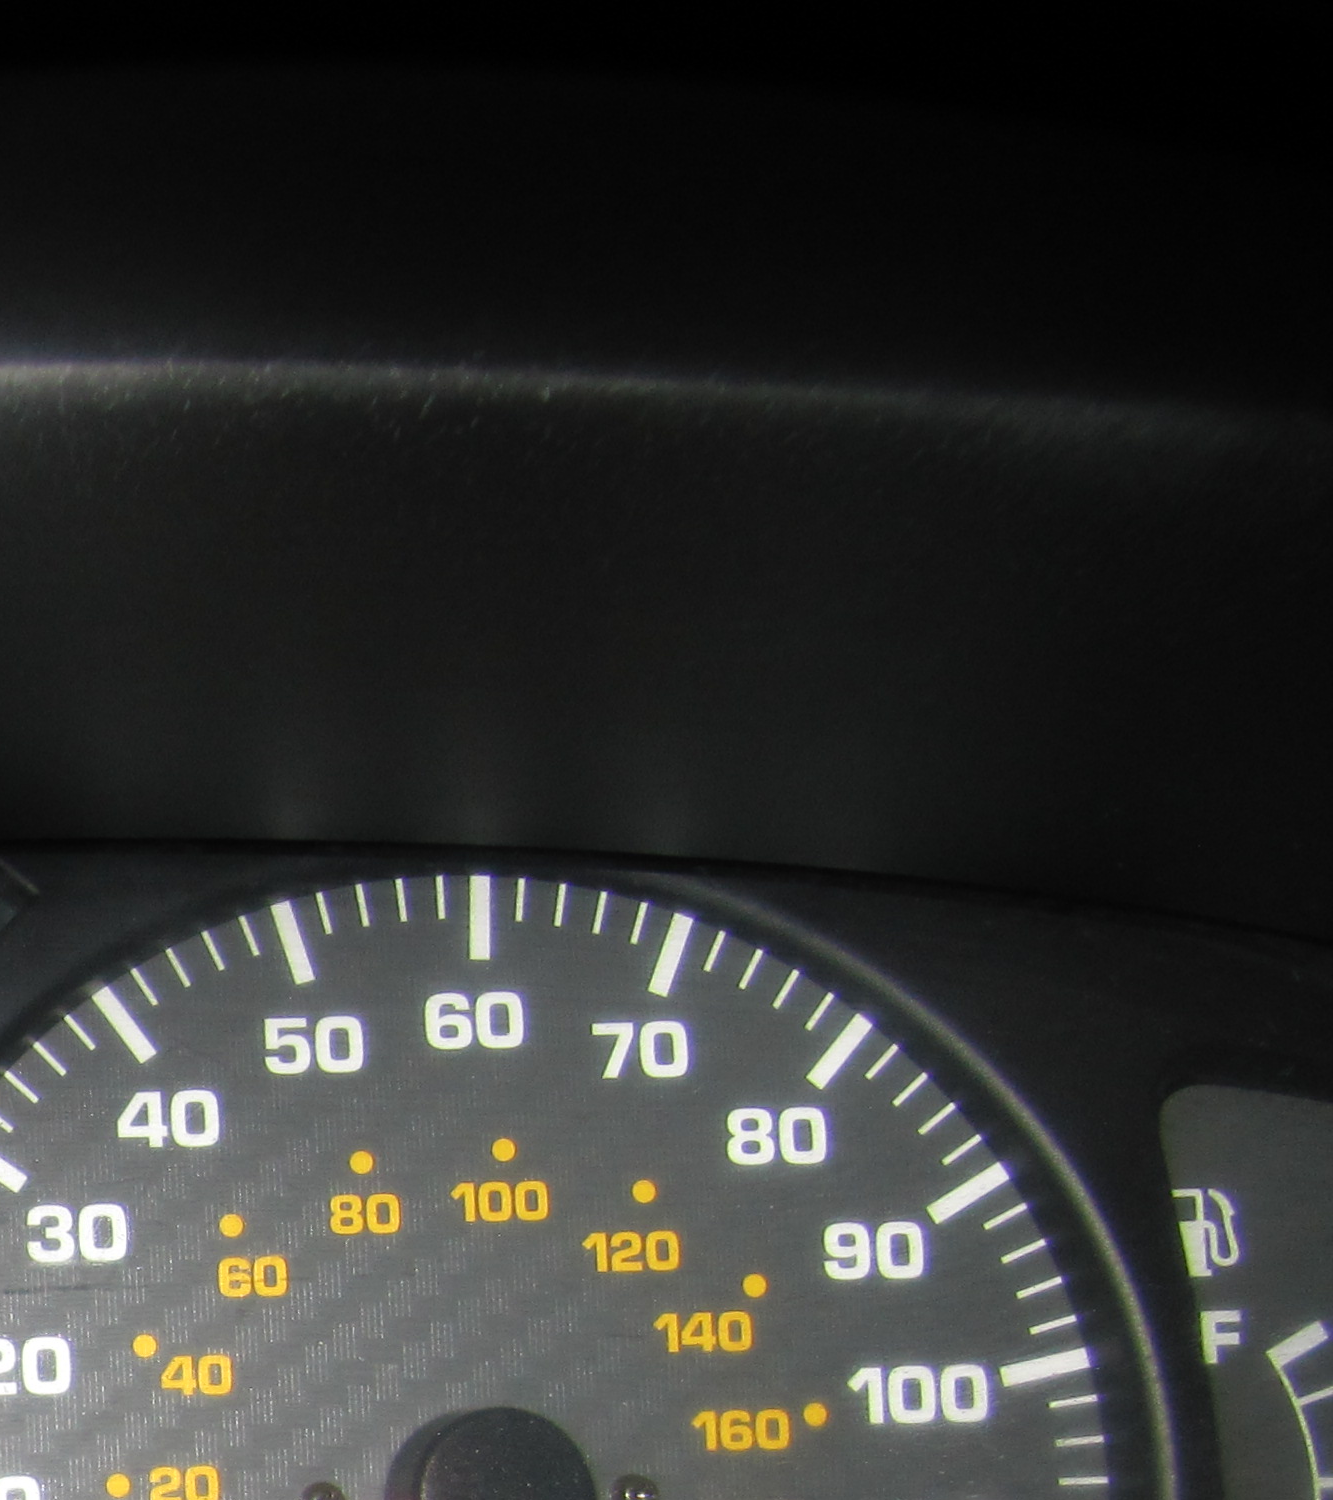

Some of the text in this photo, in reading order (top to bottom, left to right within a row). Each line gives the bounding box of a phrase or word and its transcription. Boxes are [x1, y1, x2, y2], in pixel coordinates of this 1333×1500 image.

[264, 1016, 364, 1074] 50
[425, 991, 525, 1050] 60
[592, 1021, 688, 1079] 70
[117, 1090, 220, 1148] 40
[726, 1106, 826, 1165] 80
[330, 1192, 401, 1235] 80
[451, 1181, 549, 1222] 100
[26, 1203, 127, 1263] 30
[583, 1231, 680, 1272] 120
[823, 1221, 924, 1280] 90
[218, 1255, 289, 1298] 60
[654, 1310, 753, 1353] 140
[1200, 1310, 1241, 1364] F
[161, 1355, 233, 1396] 40
[848, 1364, 990, 1425] 100
[692, 1409, 790, 1450] 160
